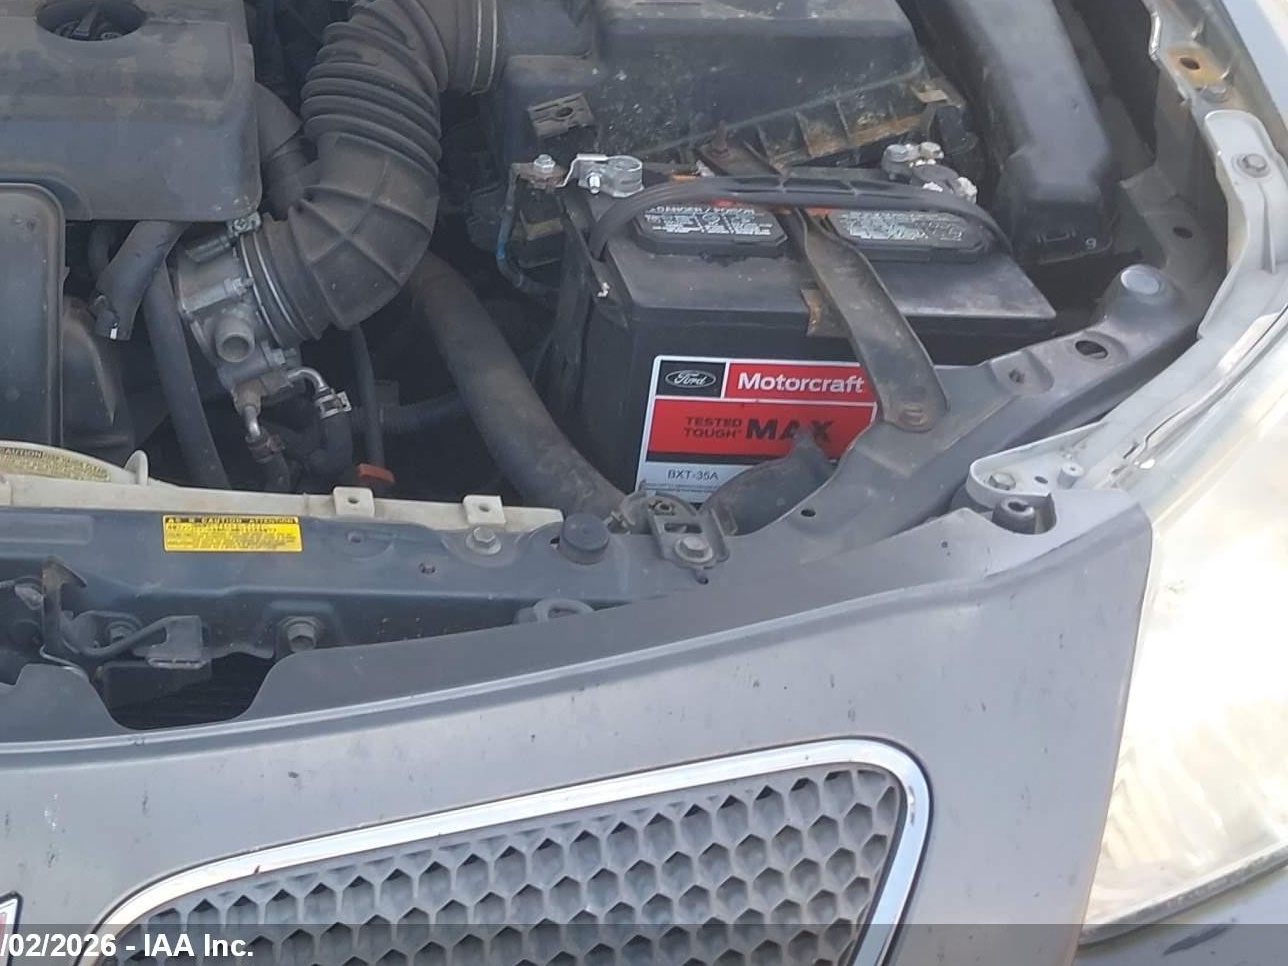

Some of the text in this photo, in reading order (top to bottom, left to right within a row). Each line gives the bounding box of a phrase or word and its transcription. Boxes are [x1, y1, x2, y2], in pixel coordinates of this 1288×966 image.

[672, 371, 865, 394] Ford Motorcraft
[685, 416, 742, 427] TESTED
[745, 418, 835, 442] MAX
[667, 469, 719, 481] BXT-35A
